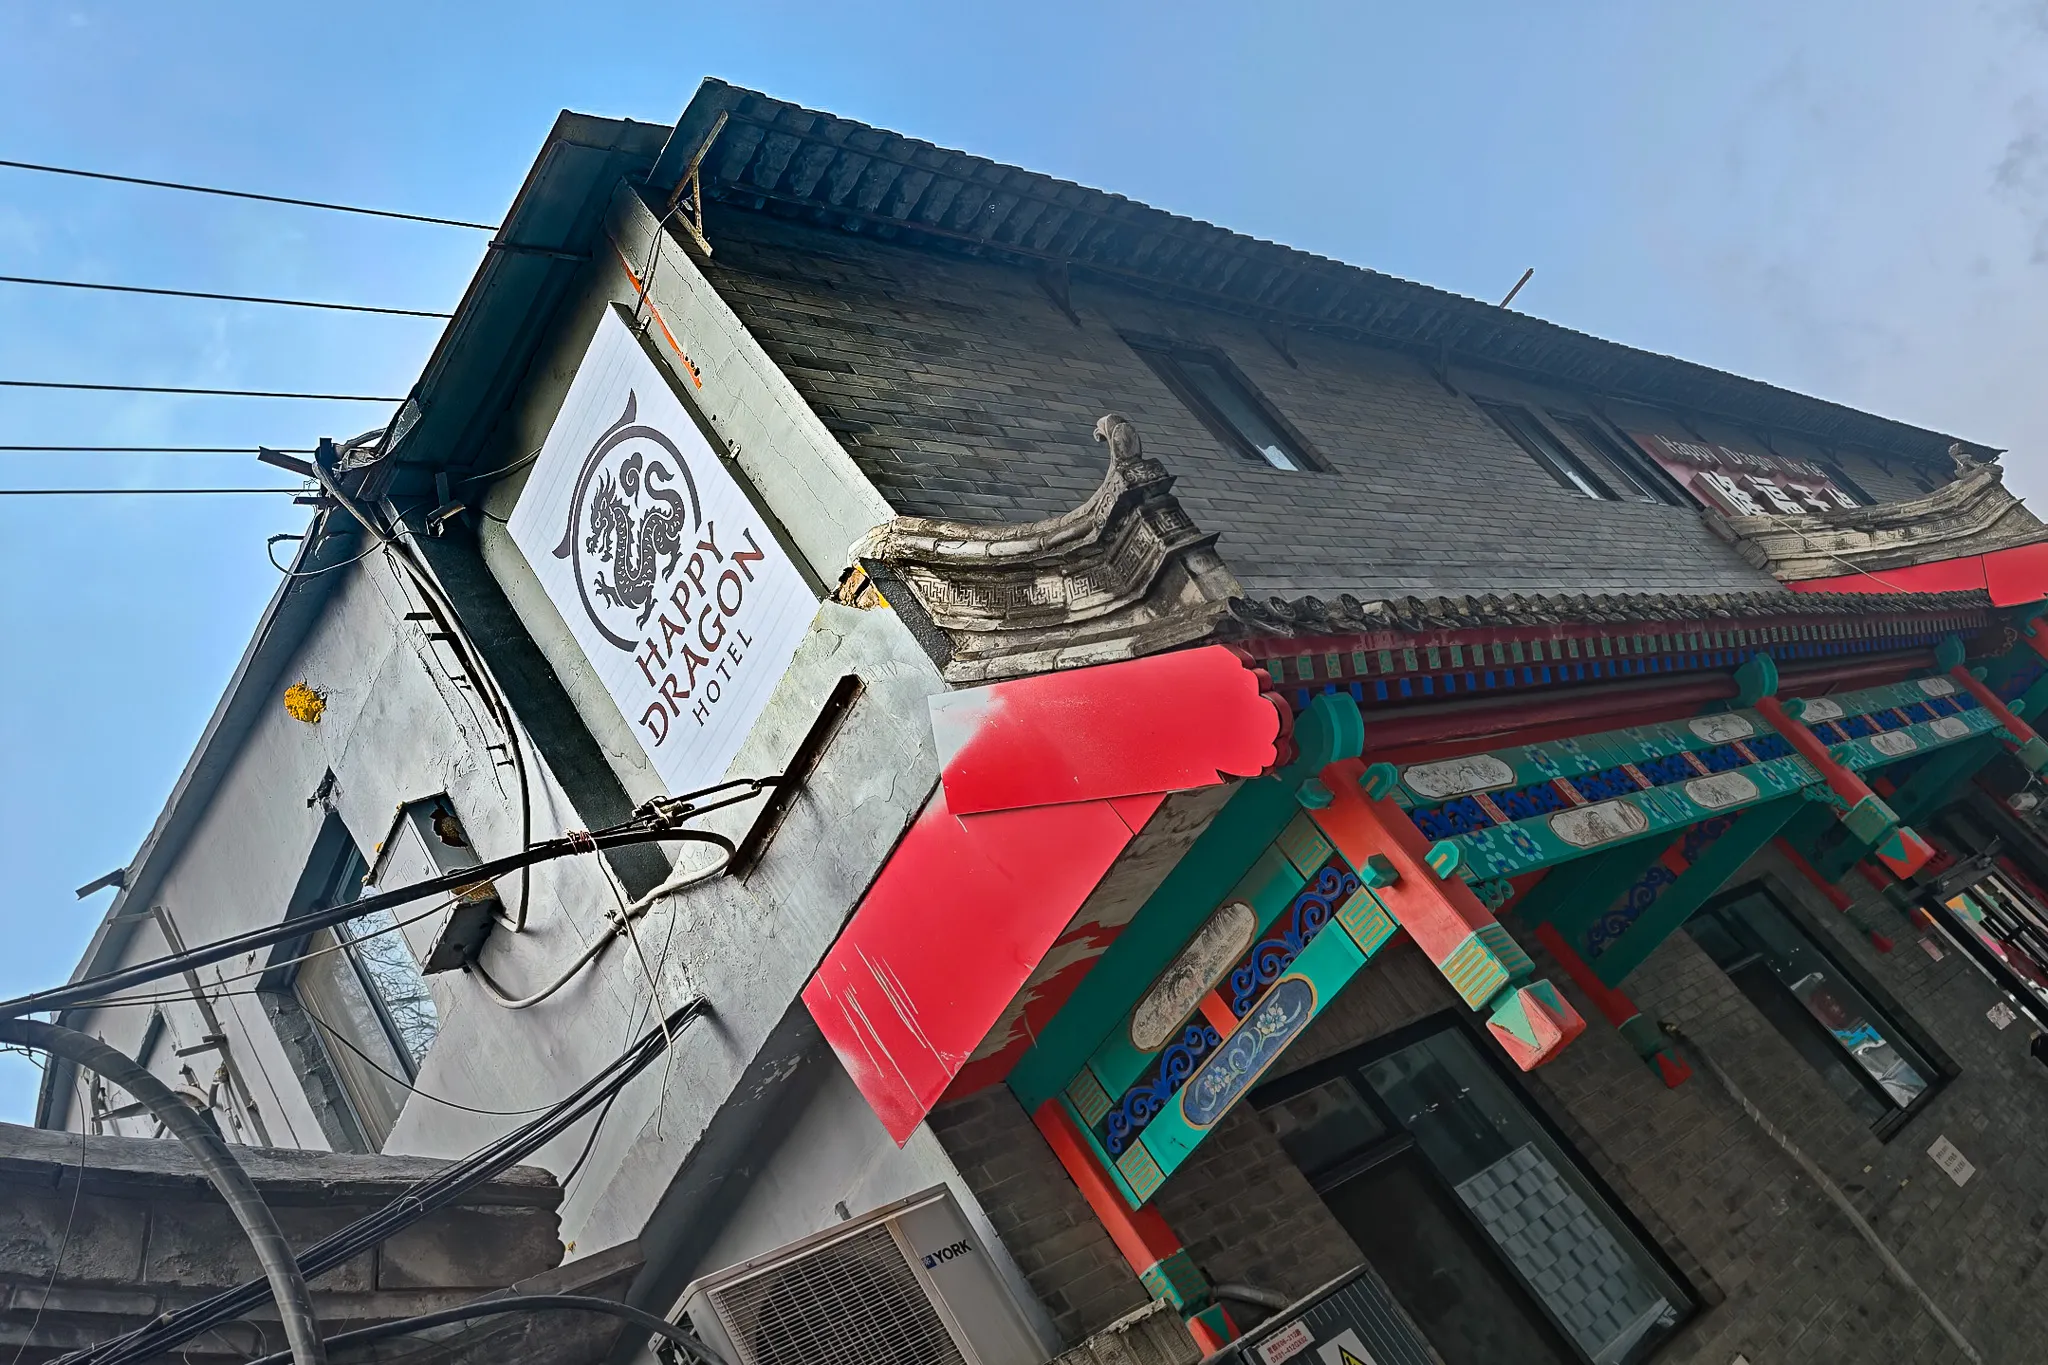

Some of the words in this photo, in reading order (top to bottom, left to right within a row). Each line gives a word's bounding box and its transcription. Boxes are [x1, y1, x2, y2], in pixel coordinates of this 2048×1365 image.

[1654, 434, 1723, 465] Happy
[1719, 446, 1781, 472] Dragon
[635, 521, 724, 687] HAPPY
[639, 528, 764, 747] DRAGON
[692, 629, 752, 727] HOTEL
[932, 1239, 972, 1263] YORK
